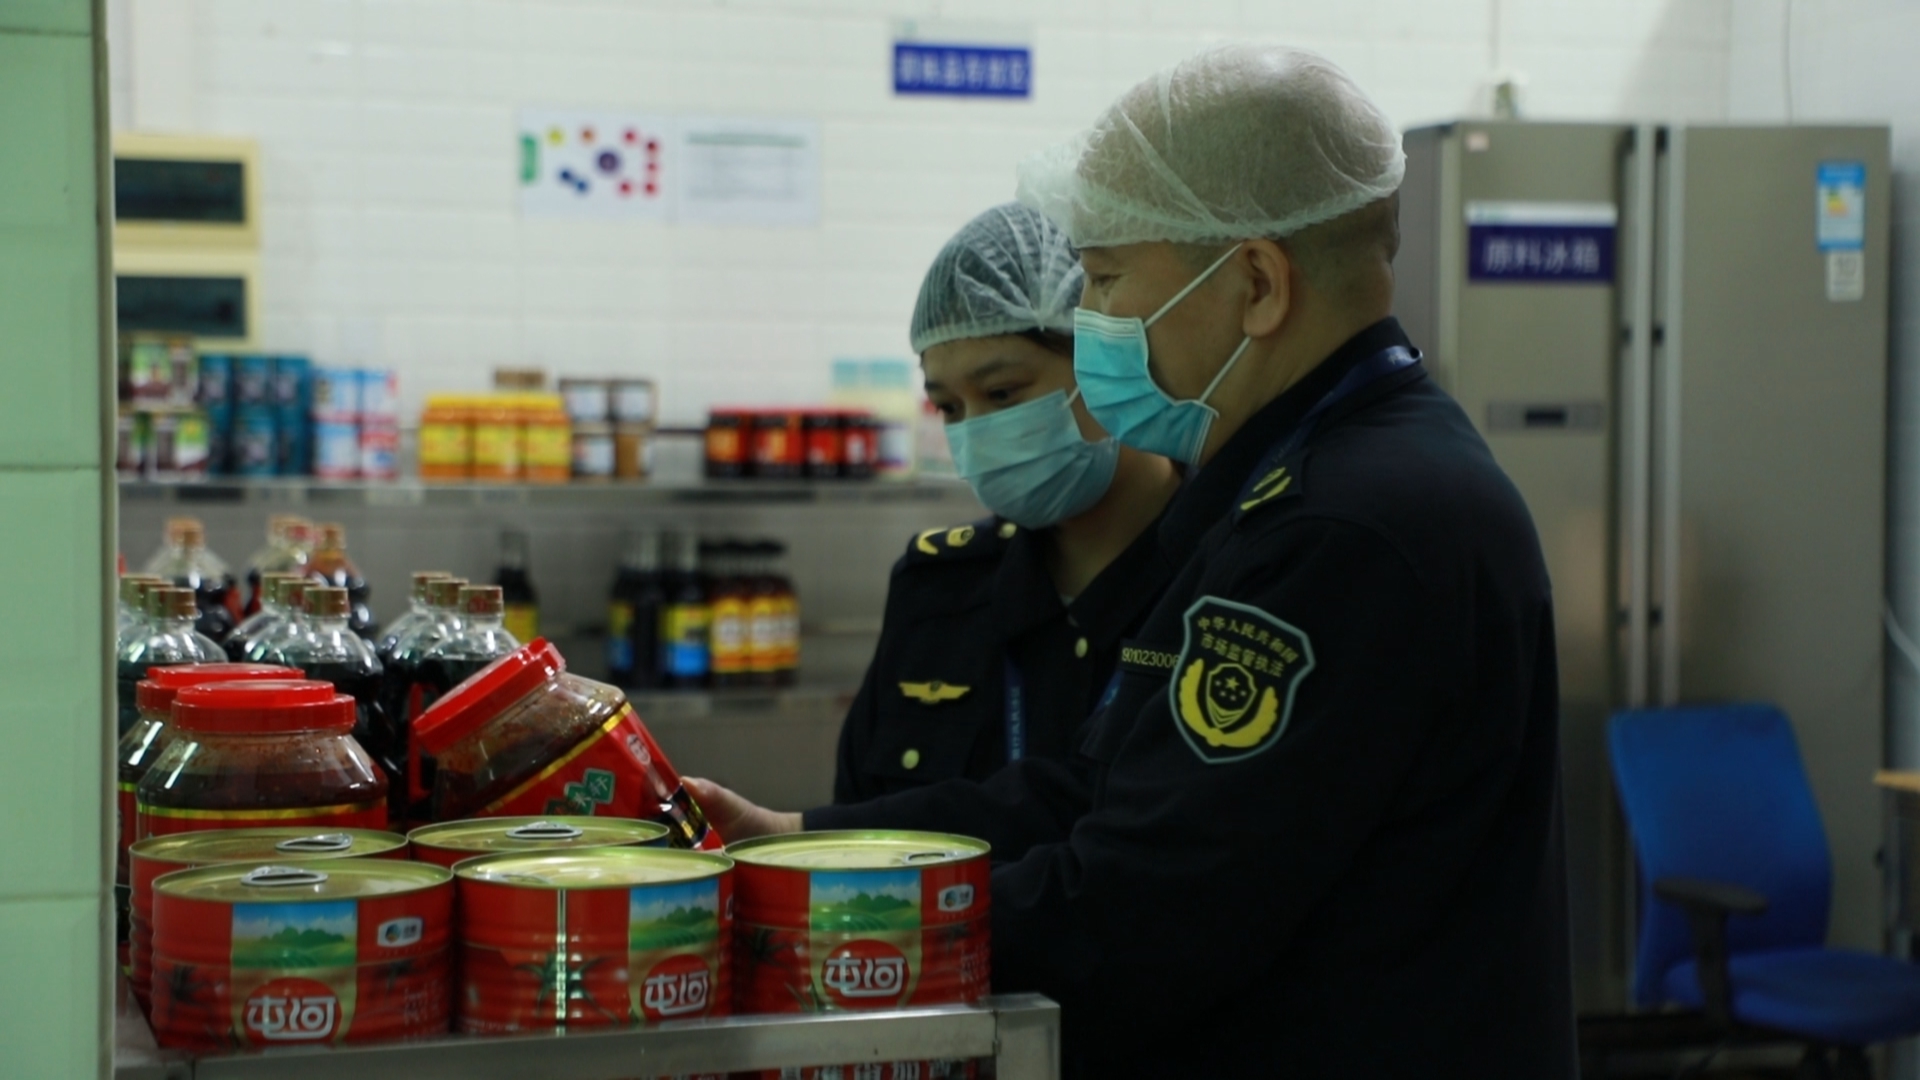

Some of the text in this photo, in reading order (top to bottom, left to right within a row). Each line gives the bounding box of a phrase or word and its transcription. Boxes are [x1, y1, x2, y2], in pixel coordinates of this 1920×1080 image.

[1198, 616, 1300, 664] 中华人民共和国
[1200, 632, 1285, 678] 市场监管执法
[644, 970, 709, 1016] 屯河
[825, 957, 905, 997] 屯河
[247, 995, 337, 1040] 屯河
